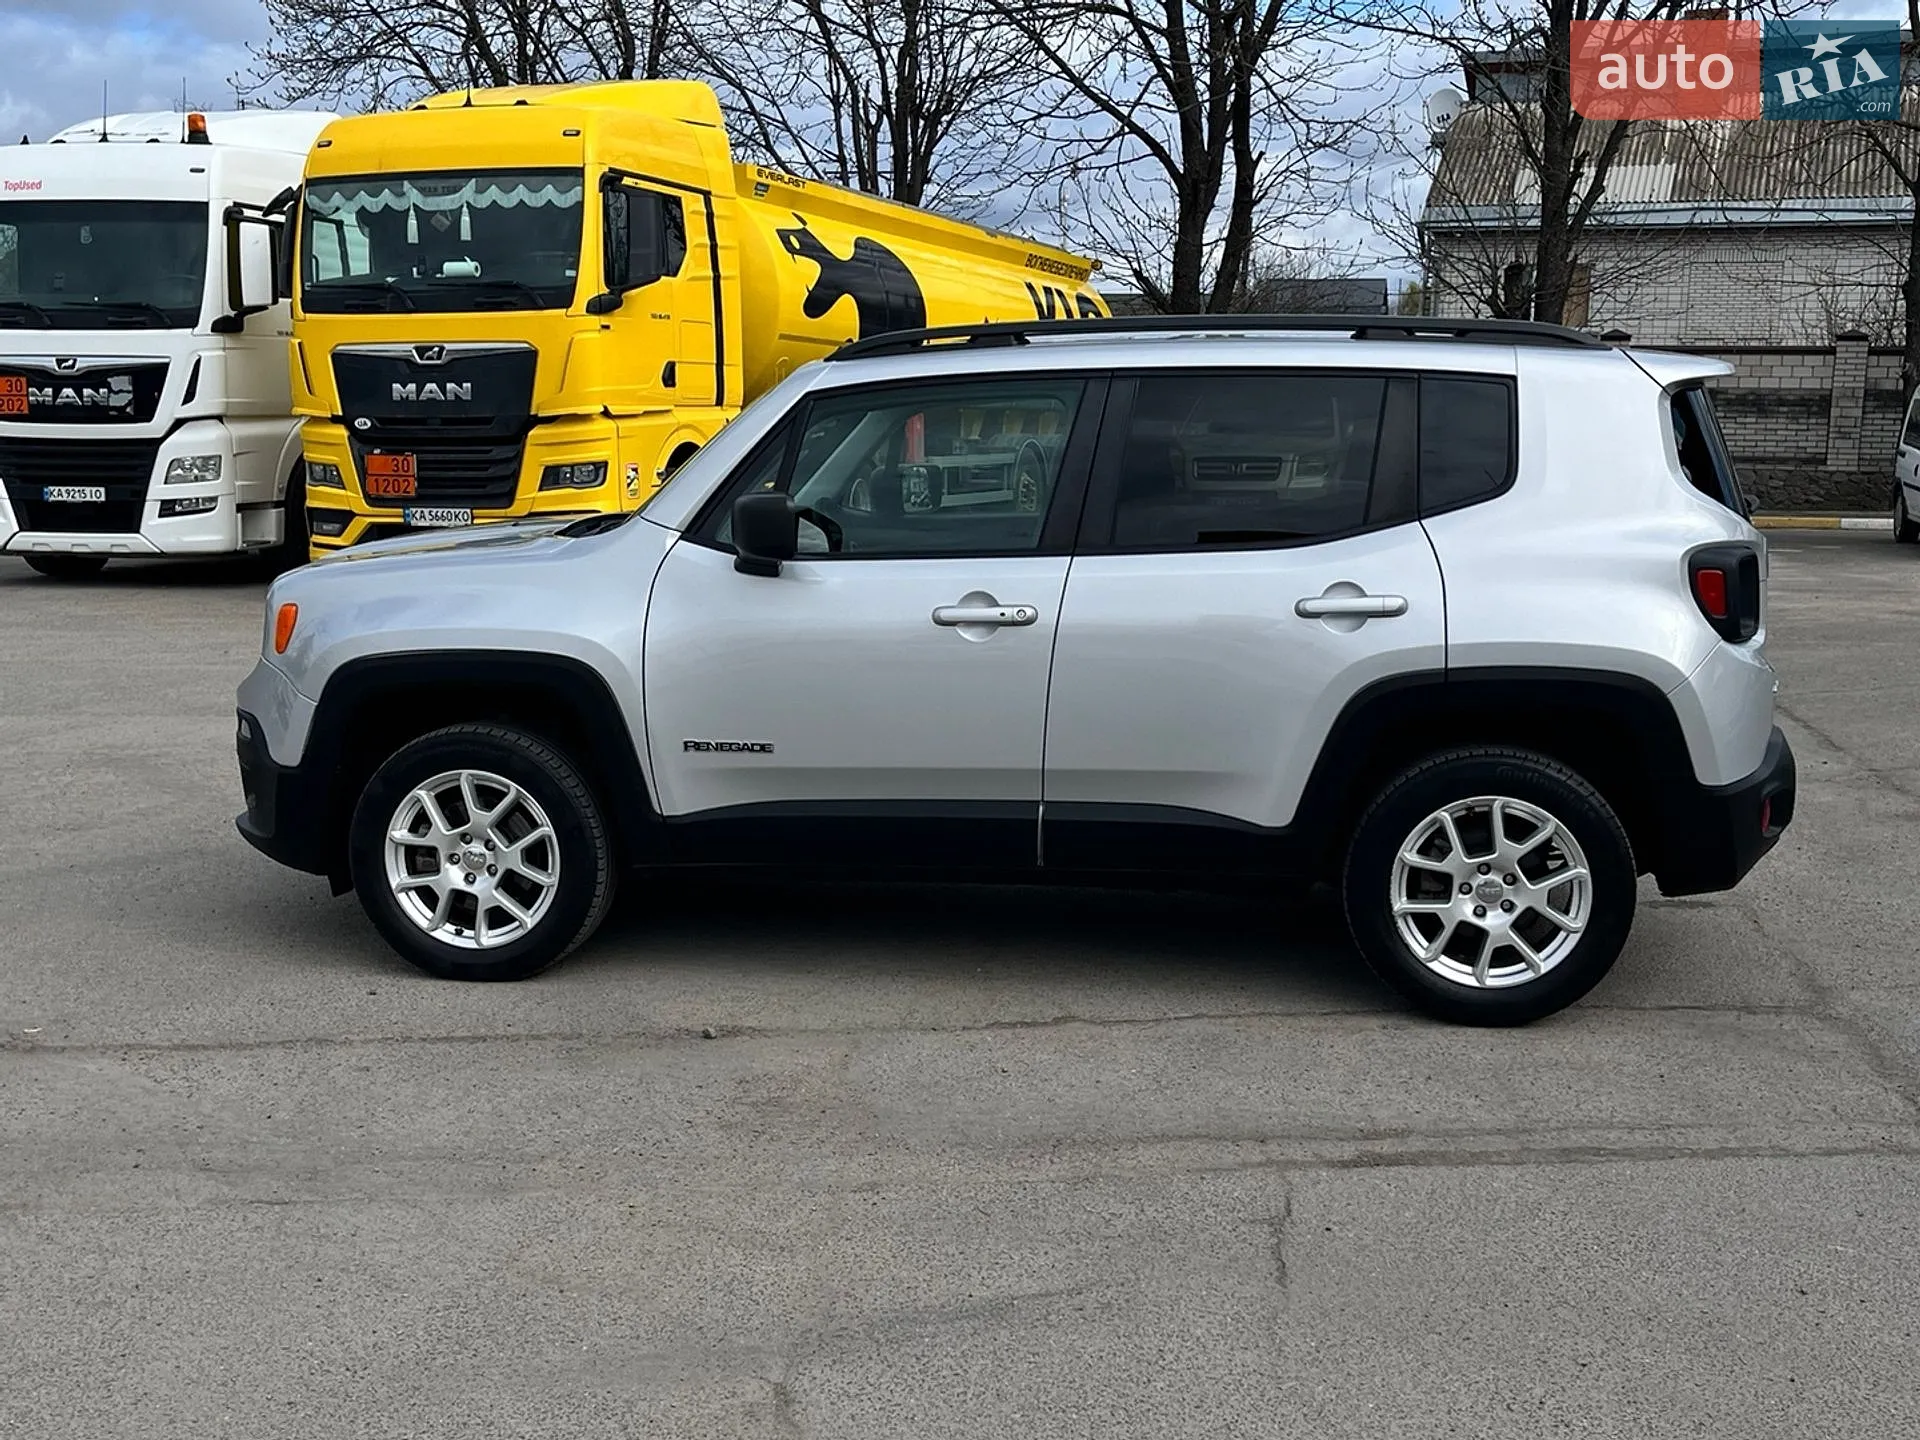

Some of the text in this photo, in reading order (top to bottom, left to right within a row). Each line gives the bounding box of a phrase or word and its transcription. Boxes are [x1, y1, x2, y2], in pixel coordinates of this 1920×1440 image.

[4, 180, 43, 192] TopUsed
[756, 168, 807, 189] EVERLAST
[6, 378, 23, 393] 30
[392, 382, 472, 401] MAN
[28, 387, 109, 406] MAN
[356, 420, 370, 428] UA
[391, 457, 411, 473] 30
[373, 477, 411, 495] 1202
[682, 739, 775, 754] RENEGADE
